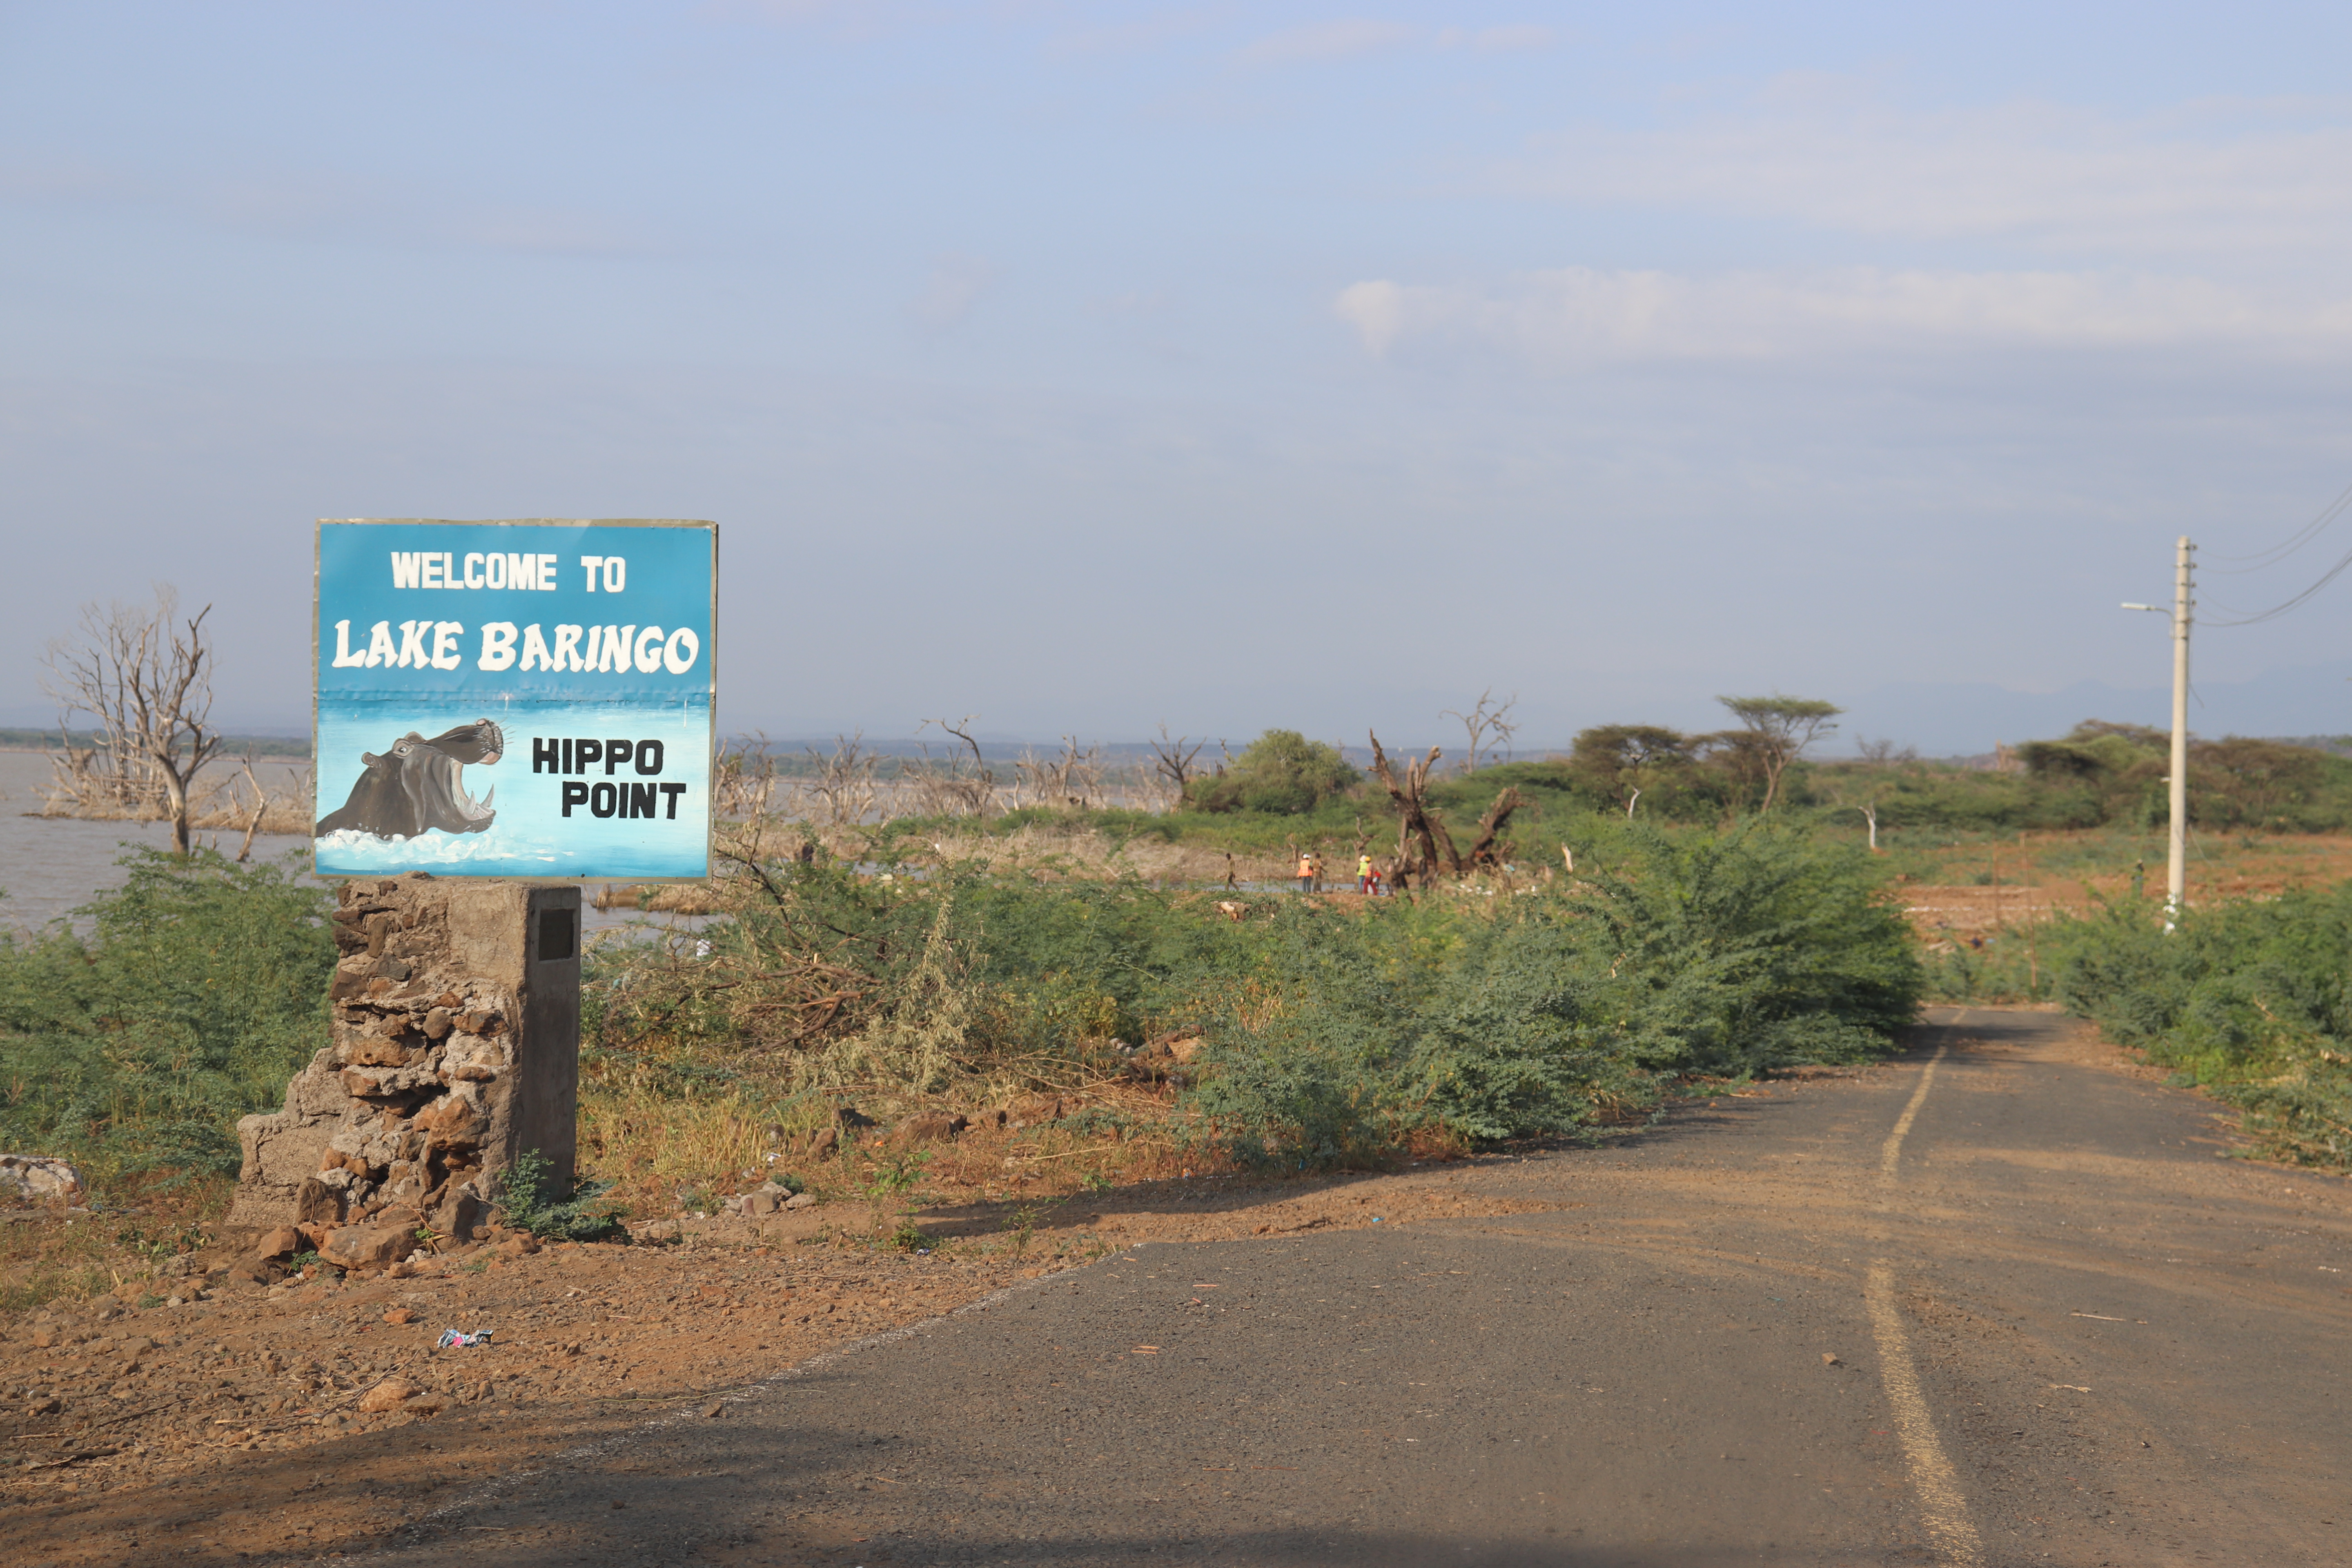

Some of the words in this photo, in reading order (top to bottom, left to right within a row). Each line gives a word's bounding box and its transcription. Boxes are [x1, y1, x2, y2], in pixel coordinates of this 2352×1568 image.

[391, 552, 557, 590] WELCOME
[581, 556, 626, 592] TO
[332, 620, 464, 671] LAKE
[477, 622, 699, 674] BARINGO
[533, 738, 664, 775] HIPPO
[562, 781, 686, 819] POINT
